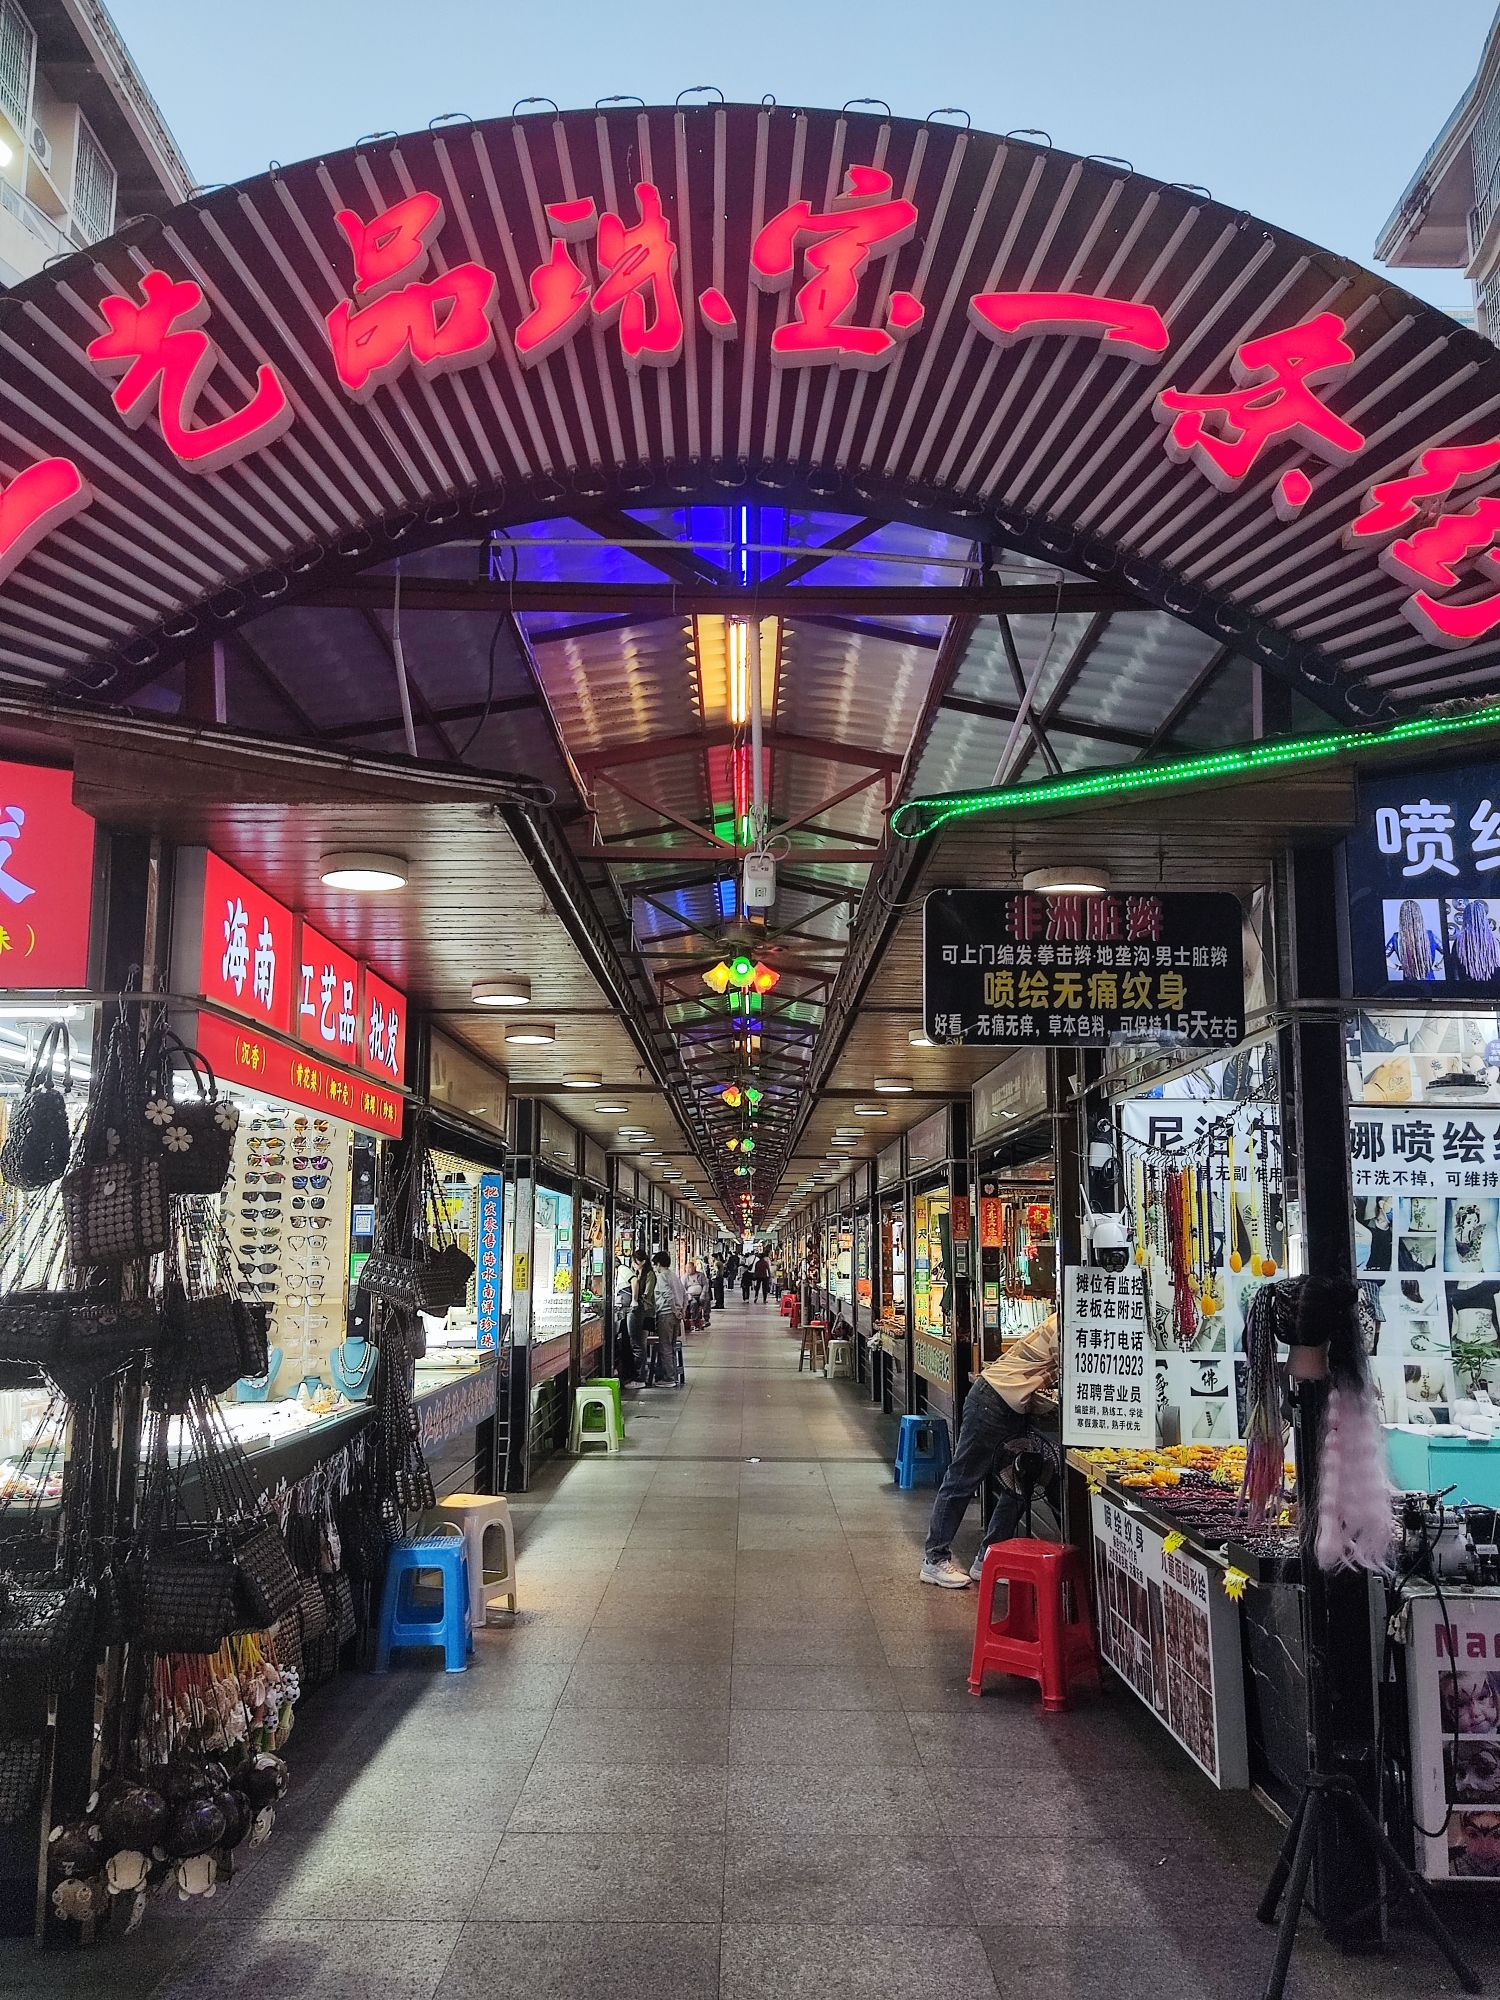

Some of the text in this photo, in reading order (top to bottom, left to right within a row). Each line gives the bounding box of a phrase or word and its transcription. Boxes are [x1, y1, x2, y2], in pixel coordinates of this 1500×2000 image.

[222, 897, 399, 1076] 海南 工艺品 批发
[983, 970, 1188, 1010] 喷绘无痛纹身
[1349, 1120, 1500, 1165] 娜喷绘
[1351, 1169, 1499, 1187] 汗洗不掉，可维持
[479, 1186, 499, 1347] 批发零售海水南洋珍珠
[1075, 1273, 1144, 1297] 摊位有监控
[1075, 1298, 1144, 1321] 老板在附近
[1075, 1327, 1144, 1351] 有事打电话
[1075, 1353, 1144, 1377] 13876712923
[1076, 1382, 1142, 1404] 招聘营业员
[1103, 1503, 1144, 1553] 喷绘纹身
[1160, 1551, 1207, 1604] 儿童面部彩绘
